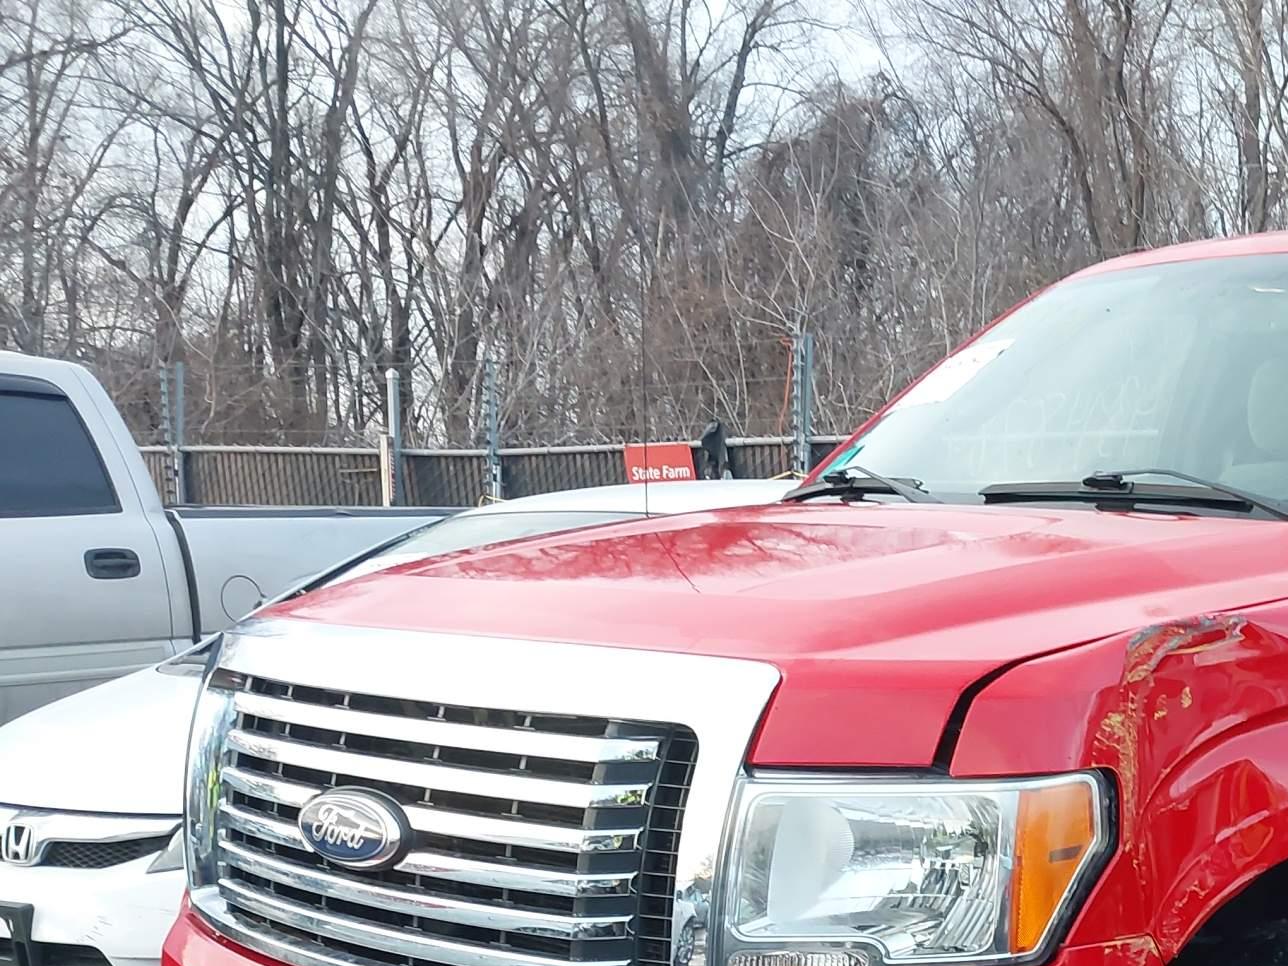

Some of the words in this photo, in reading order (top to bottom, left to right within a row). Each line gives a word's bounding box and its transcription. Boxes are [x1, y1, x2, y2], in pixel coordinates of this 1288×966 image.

[632, 466, 660, 481] State
[662, 464, 690, 479] Farm
[311, 804, 367, 850] Ford
